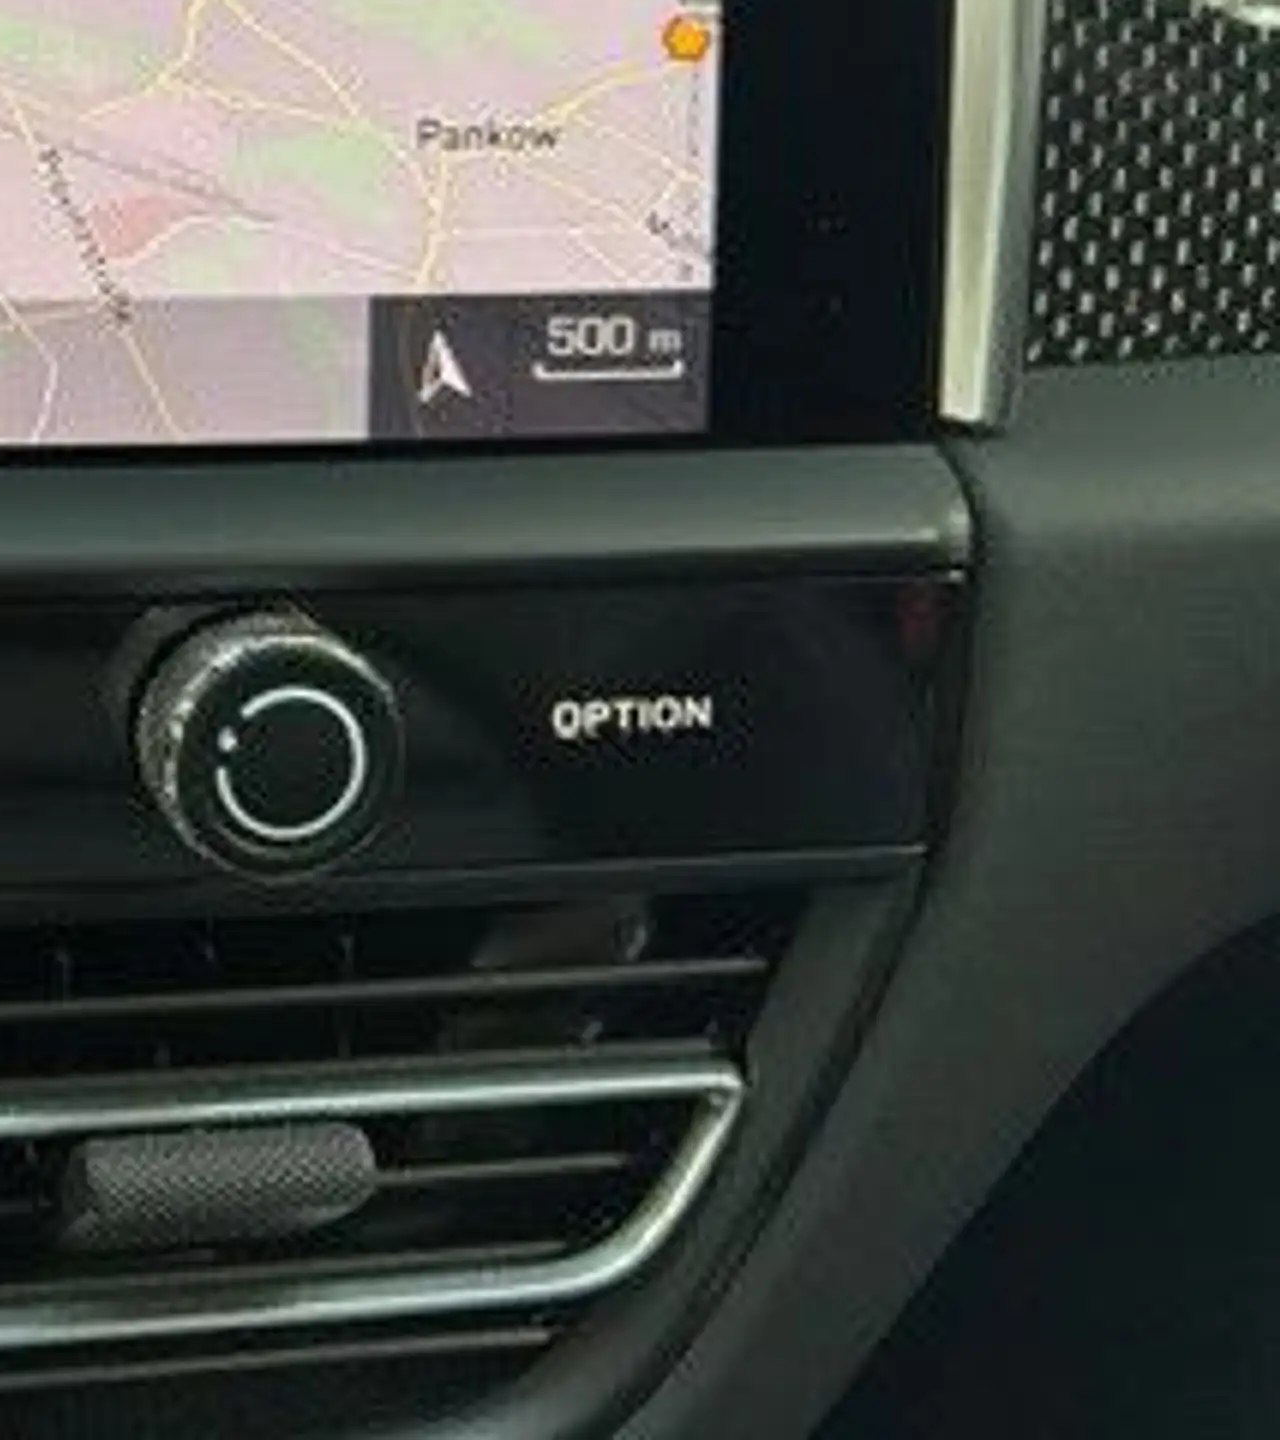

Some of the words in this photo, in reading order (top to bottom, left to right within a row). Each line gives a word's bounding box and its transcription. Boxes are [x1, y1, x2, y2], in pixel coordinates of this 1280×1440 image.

[416, 120, 560, 152] Pankow
[547, 318, 635, 358] 500
[649, 332, 681, 355] m
[552, 695, 713, 740] OPTION
